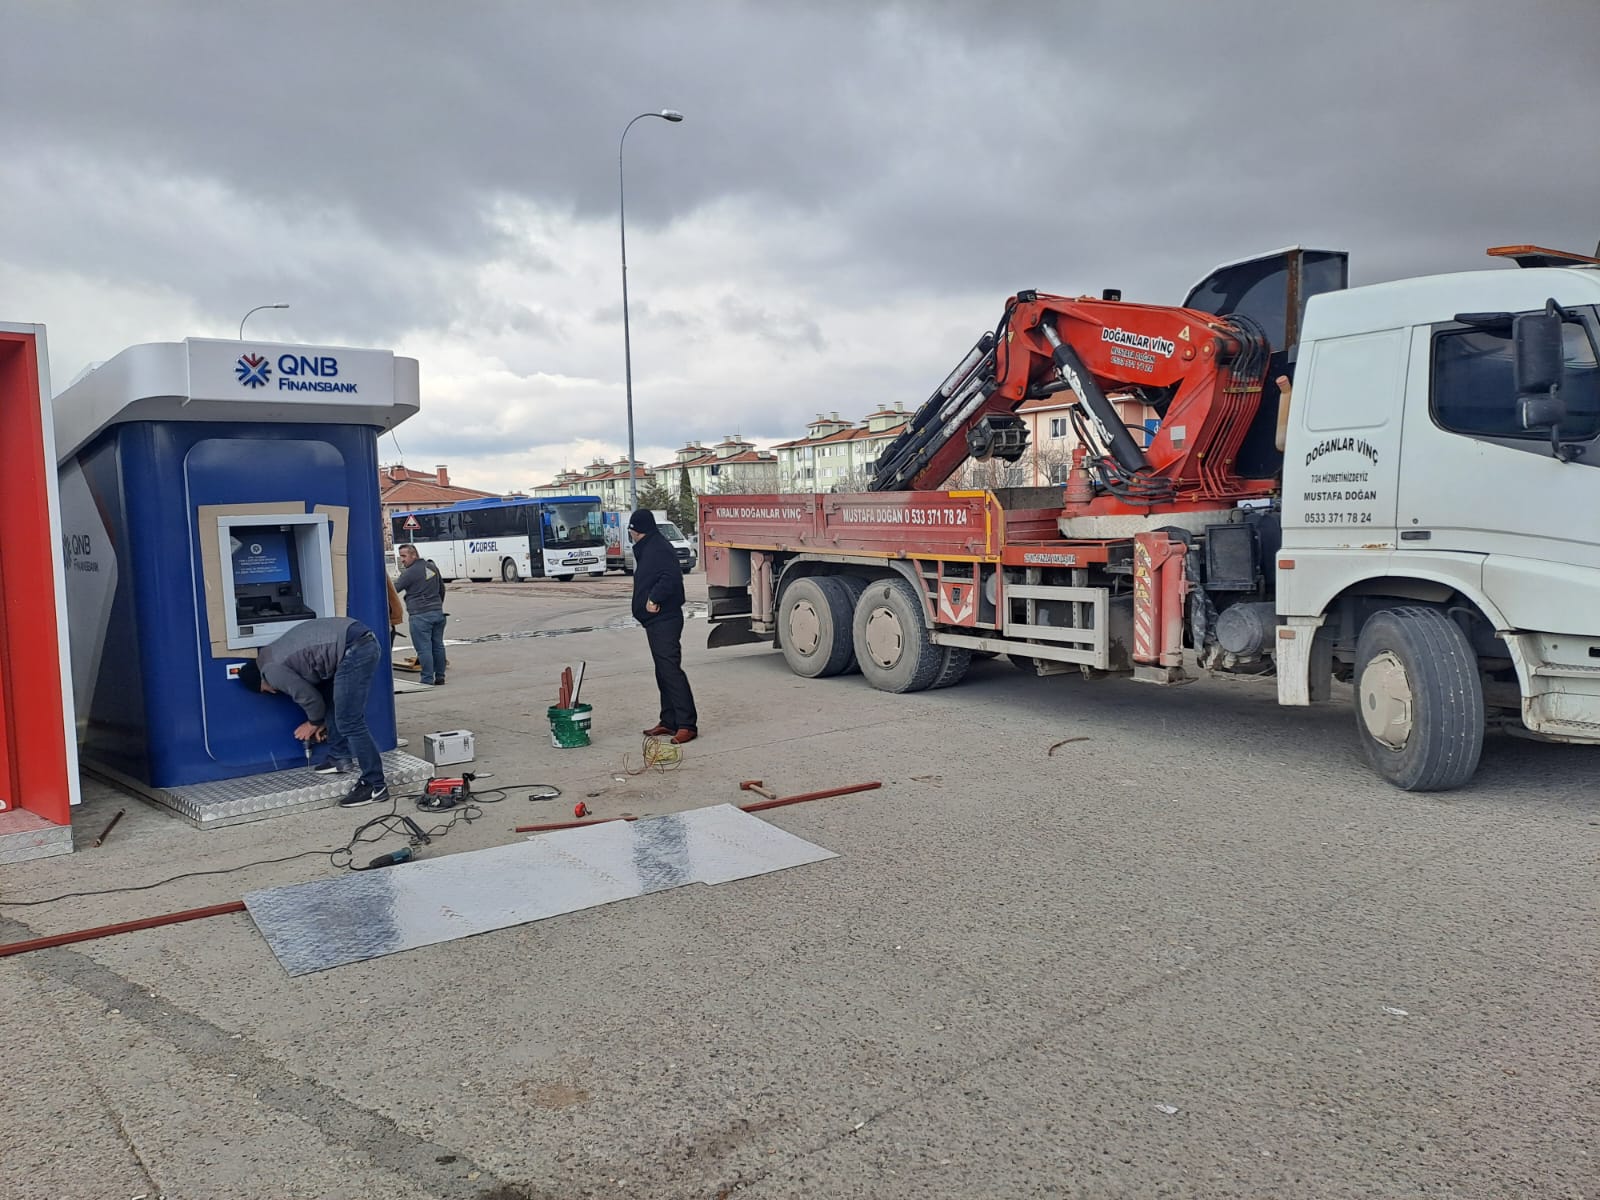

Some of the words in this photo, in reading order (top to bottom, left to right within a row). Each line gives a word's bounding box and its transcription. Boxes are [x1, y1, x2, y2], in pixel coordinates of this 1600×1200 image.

[1102, 327, 1150, 350] DOĞANLAR
[1151, 337, 1174, 357] VİNÇ
[278, 354, 338, 377] QNB
[1305, 437, 1354, 467] DOĞANLAR
[1357, 438, 1378, 467] VİNÇ
[1304, 491, 1342, 501] MUSTAFA
[1345, 489, 1376, 500] DOĞAN
[741, 506, 780, 519] DOĞANLAR
[782, 507, 801, 521] VİNÇ
[843, 508, 875, 523] MUSTAFA
[877, 506, 903, 524] DOĞAN
[905, 509, 910, 524] 0
[912, 508, 926, 525] 533
[927, 509, 941, 525] 371
[944, 509, 954, 525] 78
[957, 509, 967, 525] 24
[1304, 512, 1325, 523] 0533
[1328, 512, 1343, 523] 371
[1347, 512, 1358, 523] 78
[1360, 512, 1371, 523] 24
[72, 534, 91, 555] QNB
